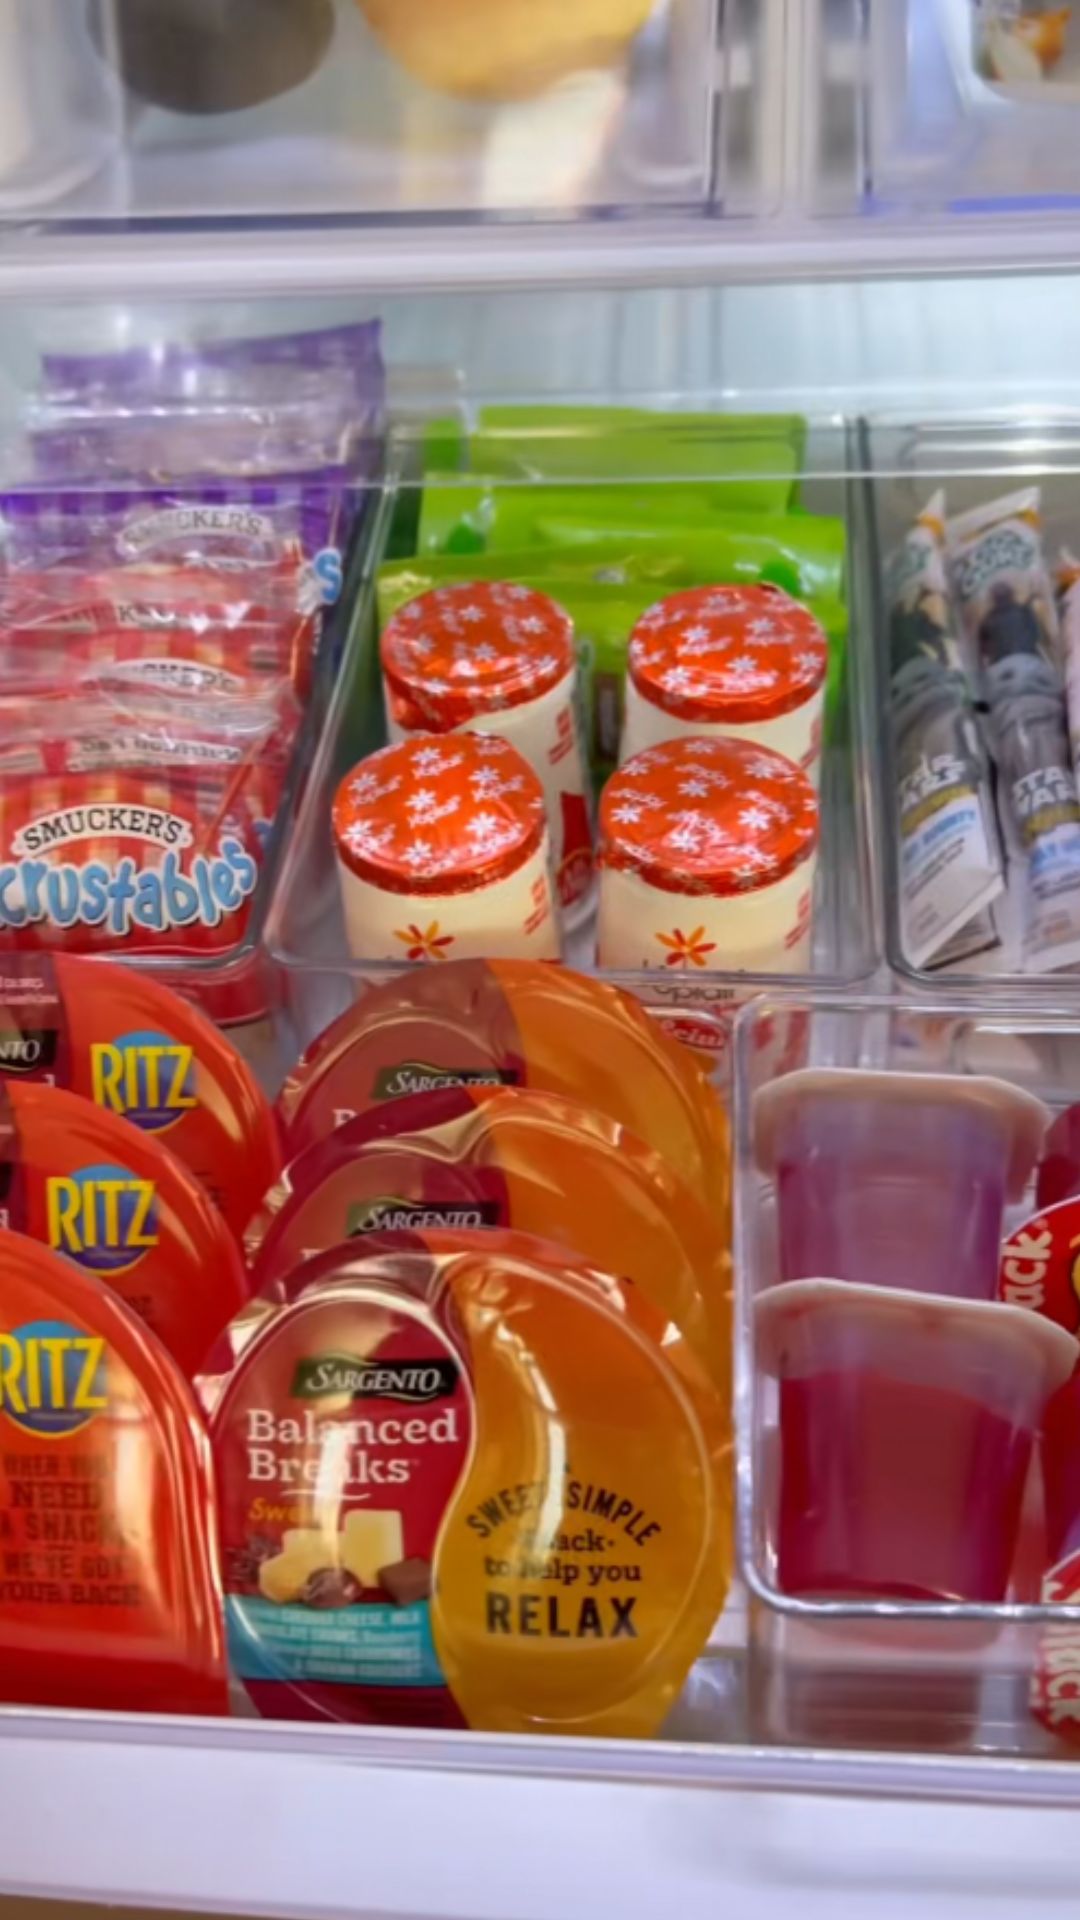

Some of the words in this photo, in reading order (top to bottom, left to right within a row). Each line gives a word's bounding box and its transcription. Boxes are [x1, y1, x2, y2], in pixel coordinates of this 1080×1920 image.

[23, 808, 183, 850] SMUCKER'S
[90, 1043, 198, 1115] RITZ
[46, 1176, 159, 1254] RITZ
[358, 1206, 482, 1232] SARGENTO
[0, 1332, 108, 1415] RITZ
[305, 1363, 441, 1393] SARGENTO
[566, 1480, 662, 1548] SIMPLE
[587, 1562, 642, 1587] you
[486, 1591, 638, 1639] RELAX
